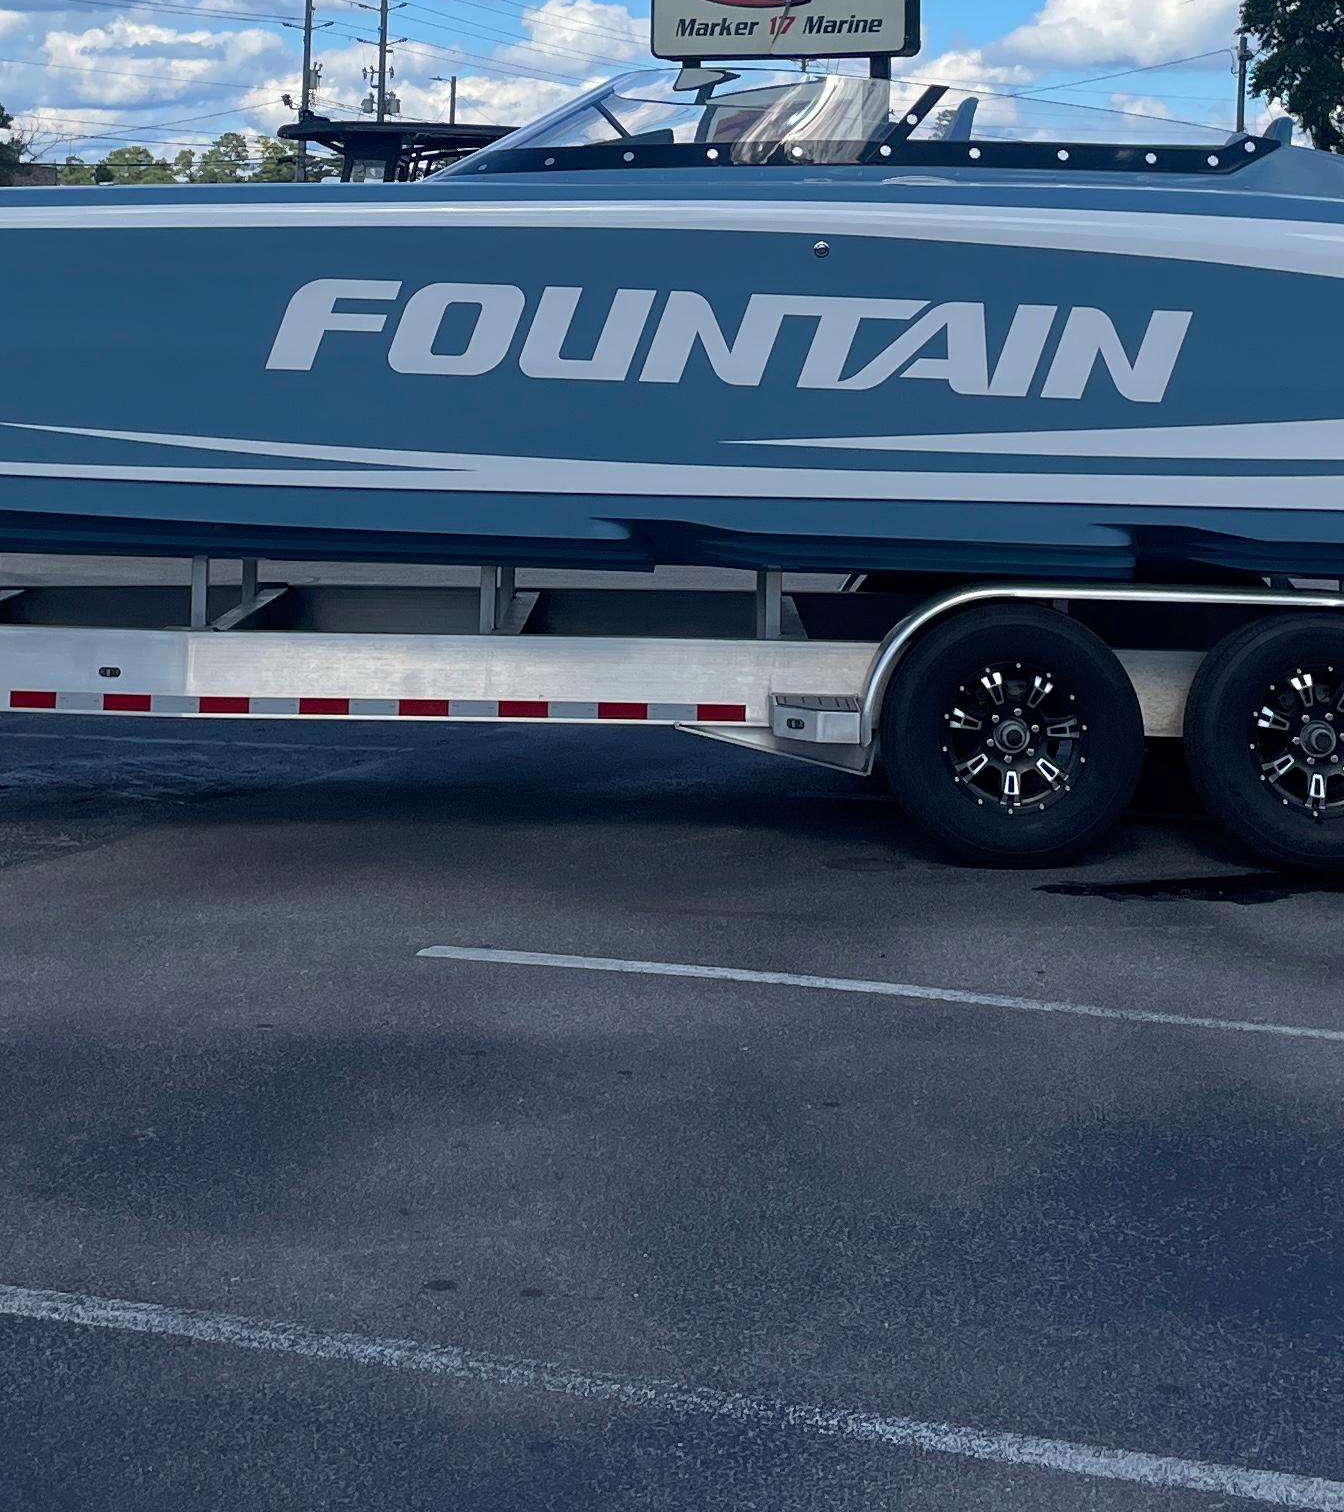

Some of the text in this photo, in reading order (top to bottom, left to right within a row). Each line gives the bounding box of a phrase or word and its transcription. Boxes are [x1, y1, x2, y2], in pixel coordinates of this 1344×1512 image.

[676, 14, 882, 37] Marker 17 Marine
[265, 278, 1194, 403] FOUNTAIN
